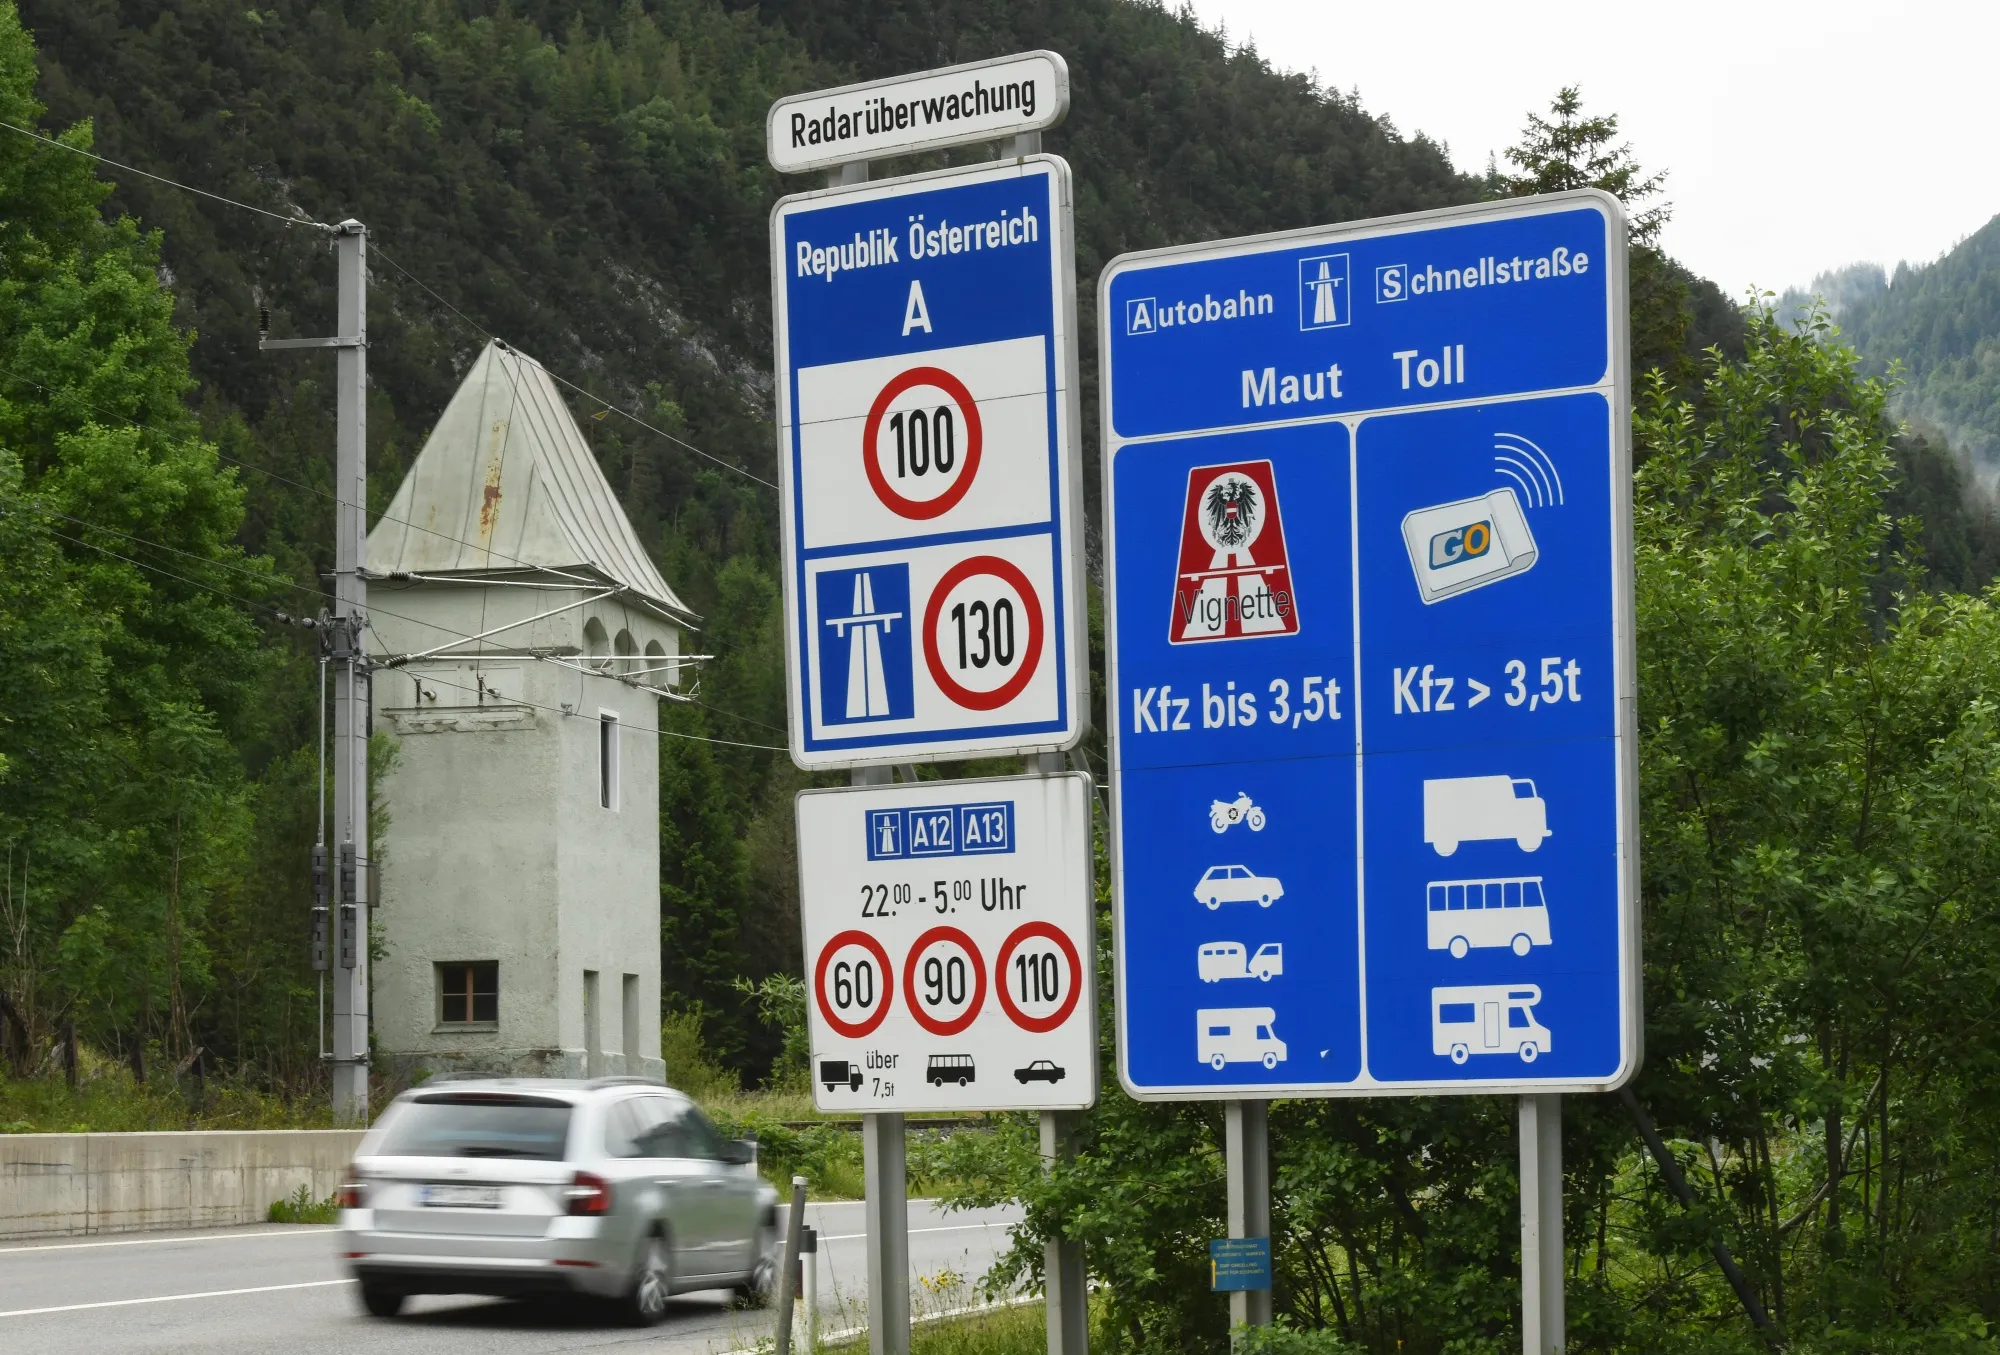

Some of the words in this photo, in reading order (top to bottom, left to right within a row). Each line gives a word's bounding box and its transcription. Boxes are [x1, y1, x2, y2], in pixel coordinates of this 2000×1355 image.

[791, 79, 1035, 148] Radarüberwachung
[797, 228, 898, 282] Republik
[909, 207, 1037, 259] Österreich
[1383, 247, 1588, 298] Schnellstraße
[902, 280, 932, 336] A
[1131, 290, 1273, 332] Autobahn
[1242, 363, 1342, 408] Maut
[1393, 345, 1464, 389] Toll
[890, 406, 954, 478] 100
[1432, 523, 1489, 566] GO
[1179, 585, 1290, 631] Vignette
[952, 598, 1014, 669] 130
[1134, 686, 1190, 733] Kfz
[1203, 682, 1257, 728] bis
[1269, 677, 1341, 729] 3,5t
[1394, 665, 1454, 714] Kfz
[1504, 657, 1581, 711] 3,5t
[913, 815, 950, 847] A12
[966, 812, 1004, 844] A13
[980, 878, 1027, 911] Uhr
[834, 960, 873, 1009] 60
[924, 957, 965, 1005] 90
[1016, 953, 1058, 1002] 110
[866, 1050, 899, 1069] über
[872, 1078, 895, 1097] 7,5t
